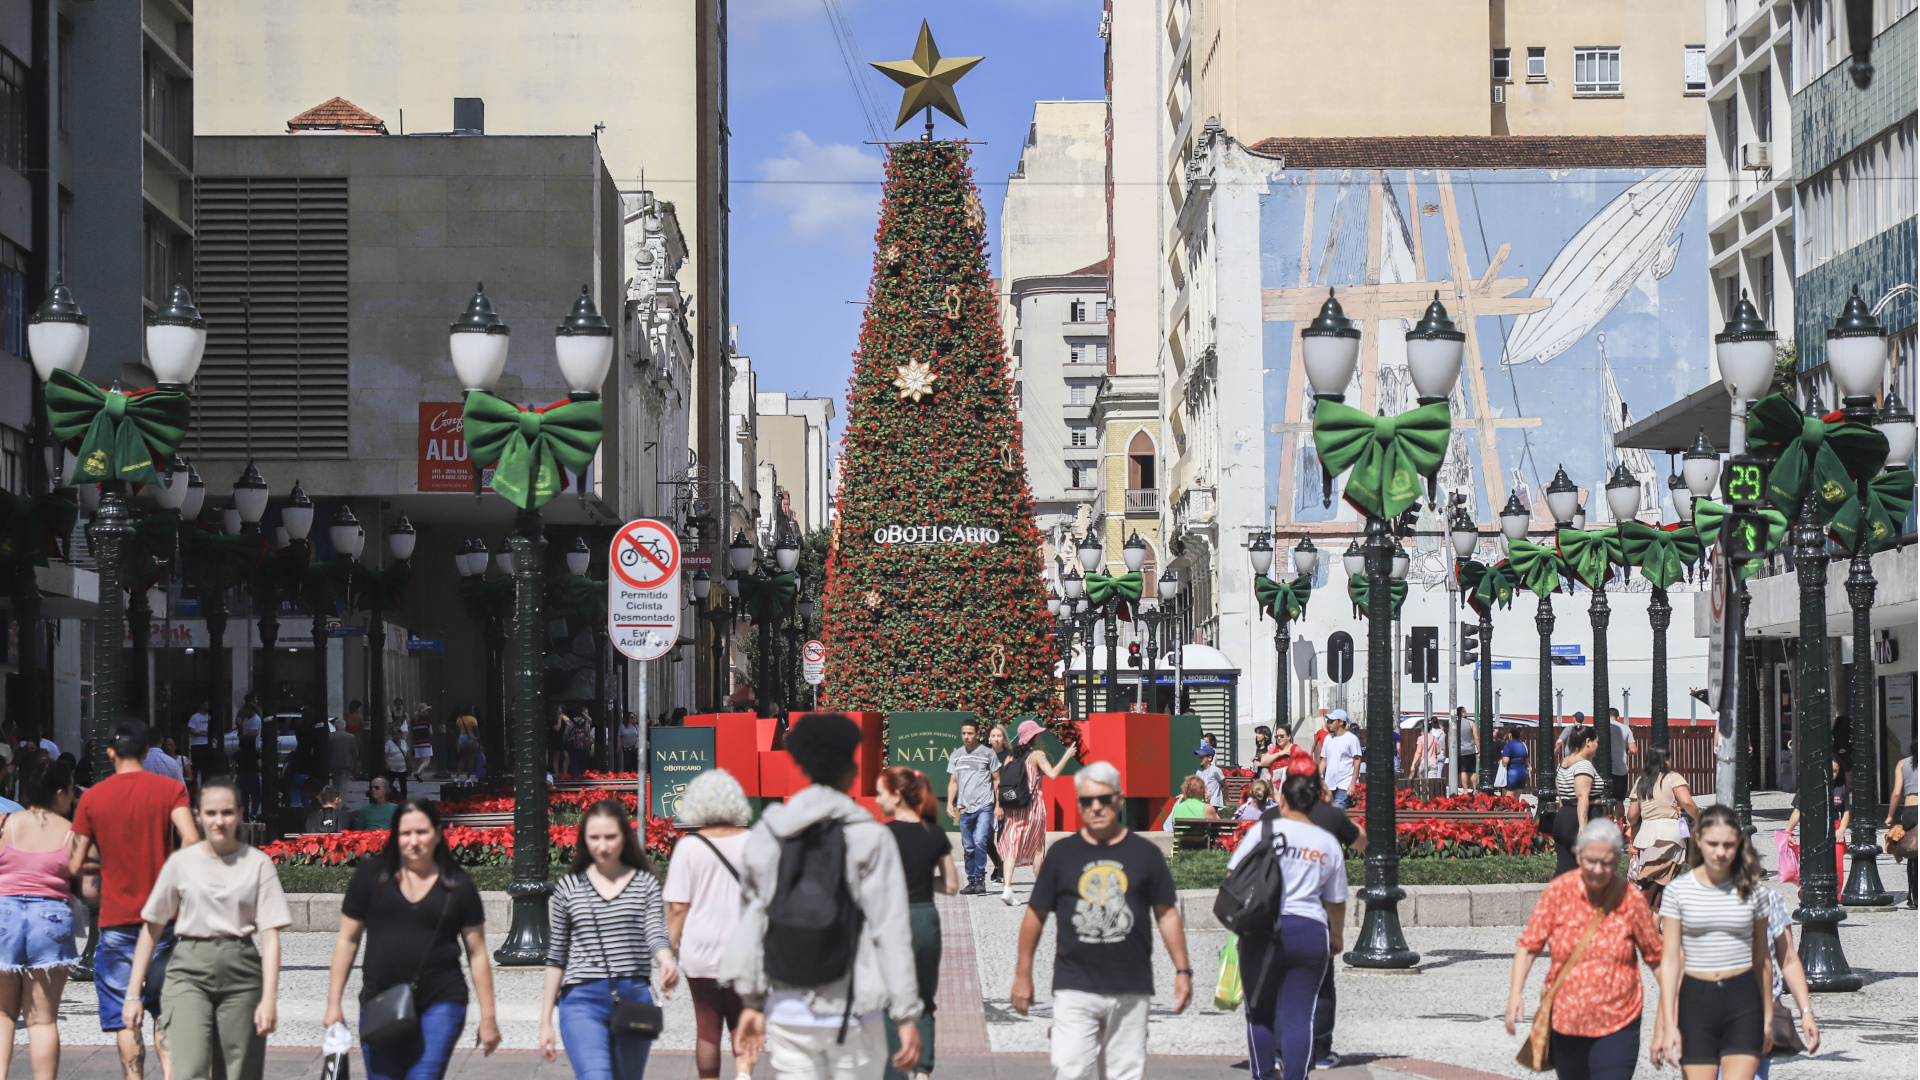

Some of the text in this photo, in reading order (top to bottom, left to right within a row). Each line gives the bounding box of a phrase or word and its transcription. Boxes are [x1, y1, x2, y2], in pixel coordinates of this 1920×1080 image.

[426, 439, 468, 461] ALU
[1729, 465, 1760, 500] 29
[681, 556, 712, 564] marisa
[621, 590, 668, 600] Permitido
[626, 602, 663, 610] Ciclista
[613, 613, 676, 622] Desmontado
[632, 629, 653, 638] Evi
[1163, 674, 1219, 682] BANA MOREIRA
[933, 731, 957, 740] PRESENTE
[656, 750, 709, 761] NATAL
[897, 747, 957, 762] NATA
